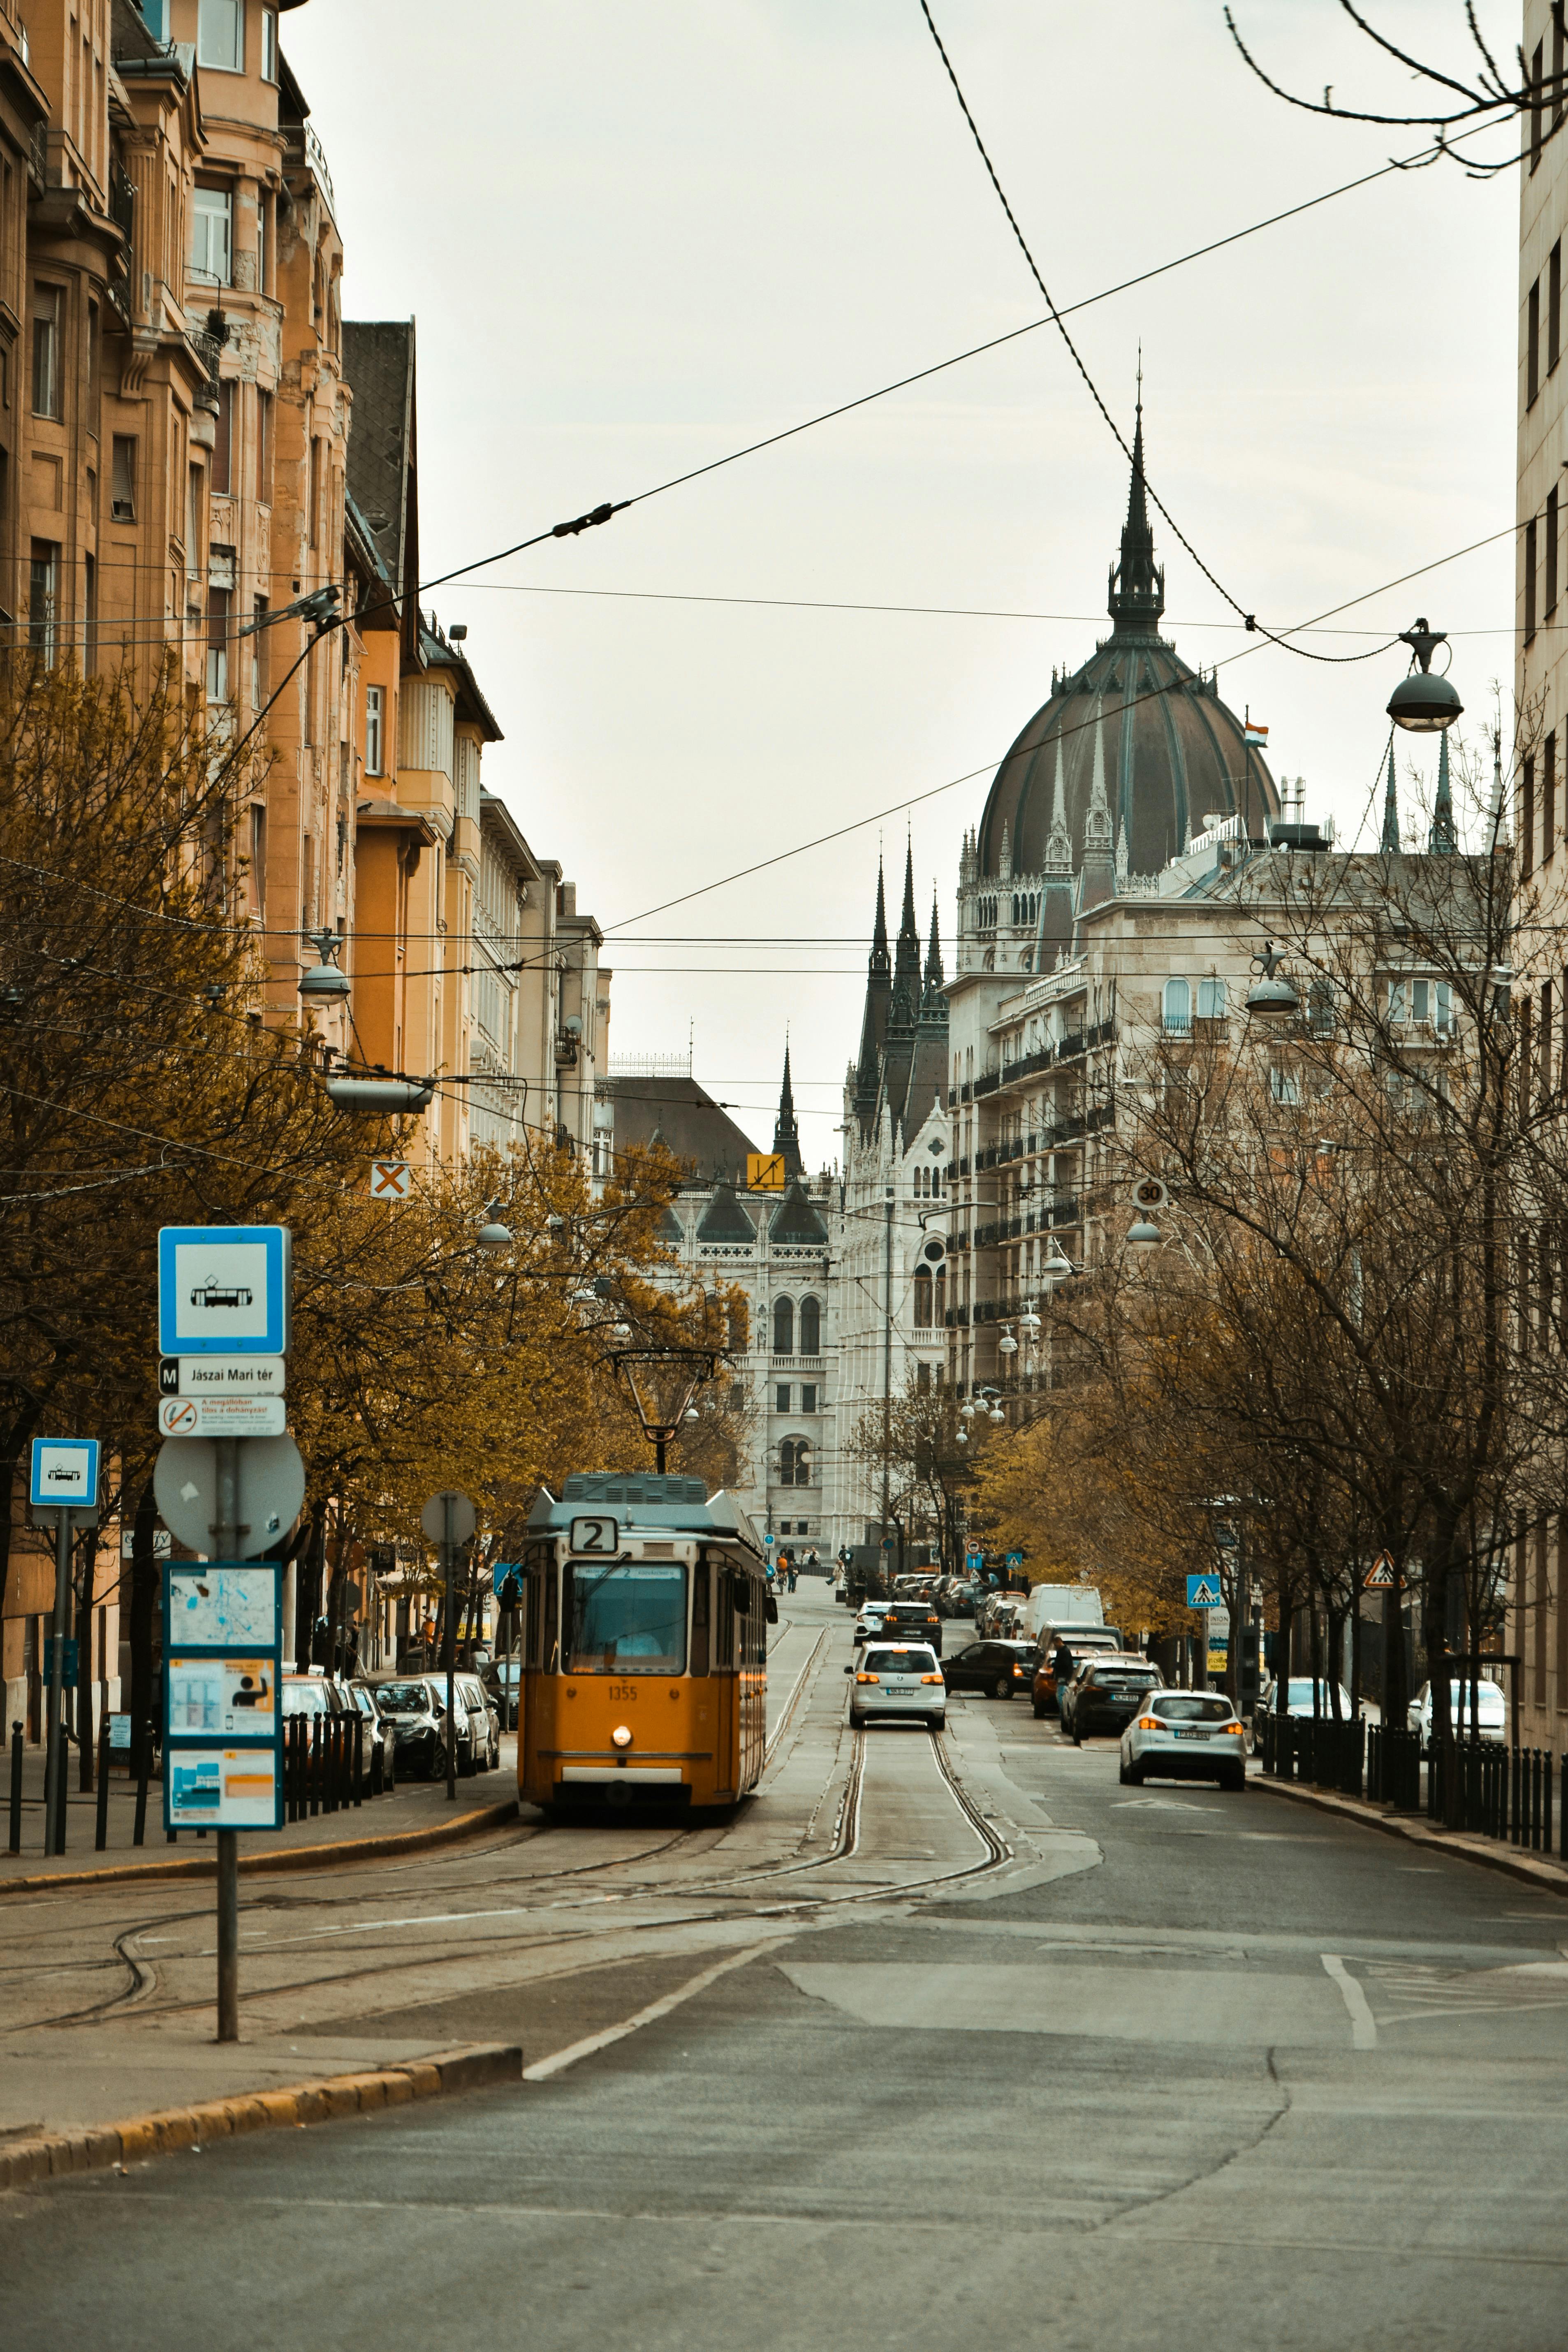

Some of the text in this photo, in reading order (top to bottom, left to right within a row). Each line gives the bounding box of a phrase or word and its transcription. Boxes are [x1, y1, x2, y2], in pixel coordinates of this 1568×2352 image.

[1140, 1186, 1160, 1200] 30
[163, 1368, 273, 1384] M Jászai Mari tér
[583, 1522, 603, 1550] 2
[623, 1568, 631, 1578] 2
[609, 1686, 637, 1701] 1355
